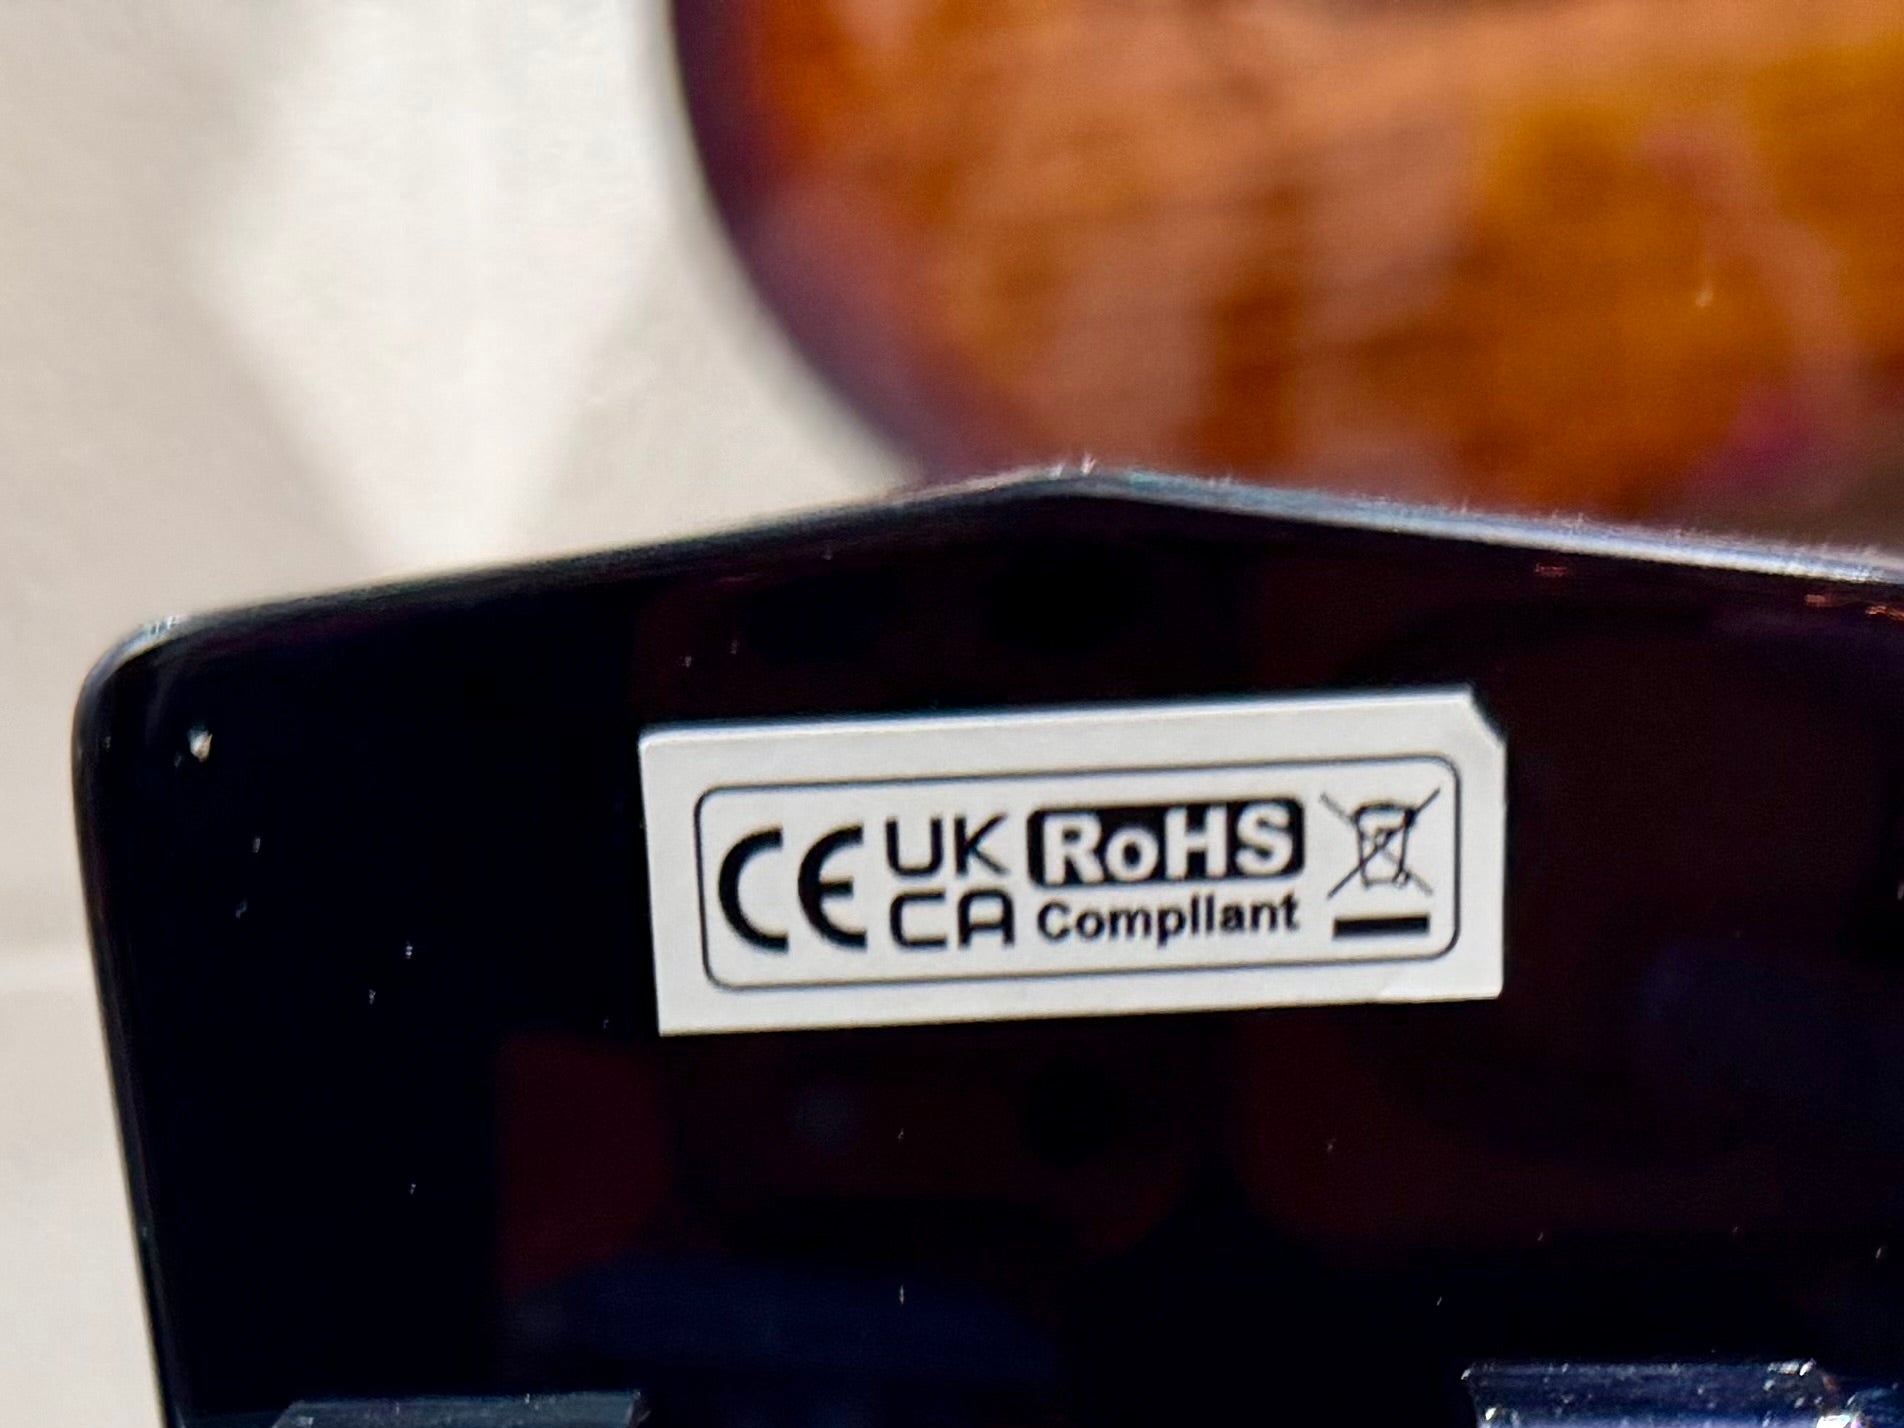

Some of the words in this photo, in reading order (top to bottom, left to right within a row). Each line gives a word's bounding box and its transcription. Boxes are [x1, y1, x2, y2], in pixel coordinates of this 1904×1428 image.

[885, 813, 1010, 879] UK
[1042, 803, 1295, 886] RoHS
[717, 825, 869, 954] CE
[888, 887, 1016, 951] CA
[1036, 893, 1300, 948] Compliant
